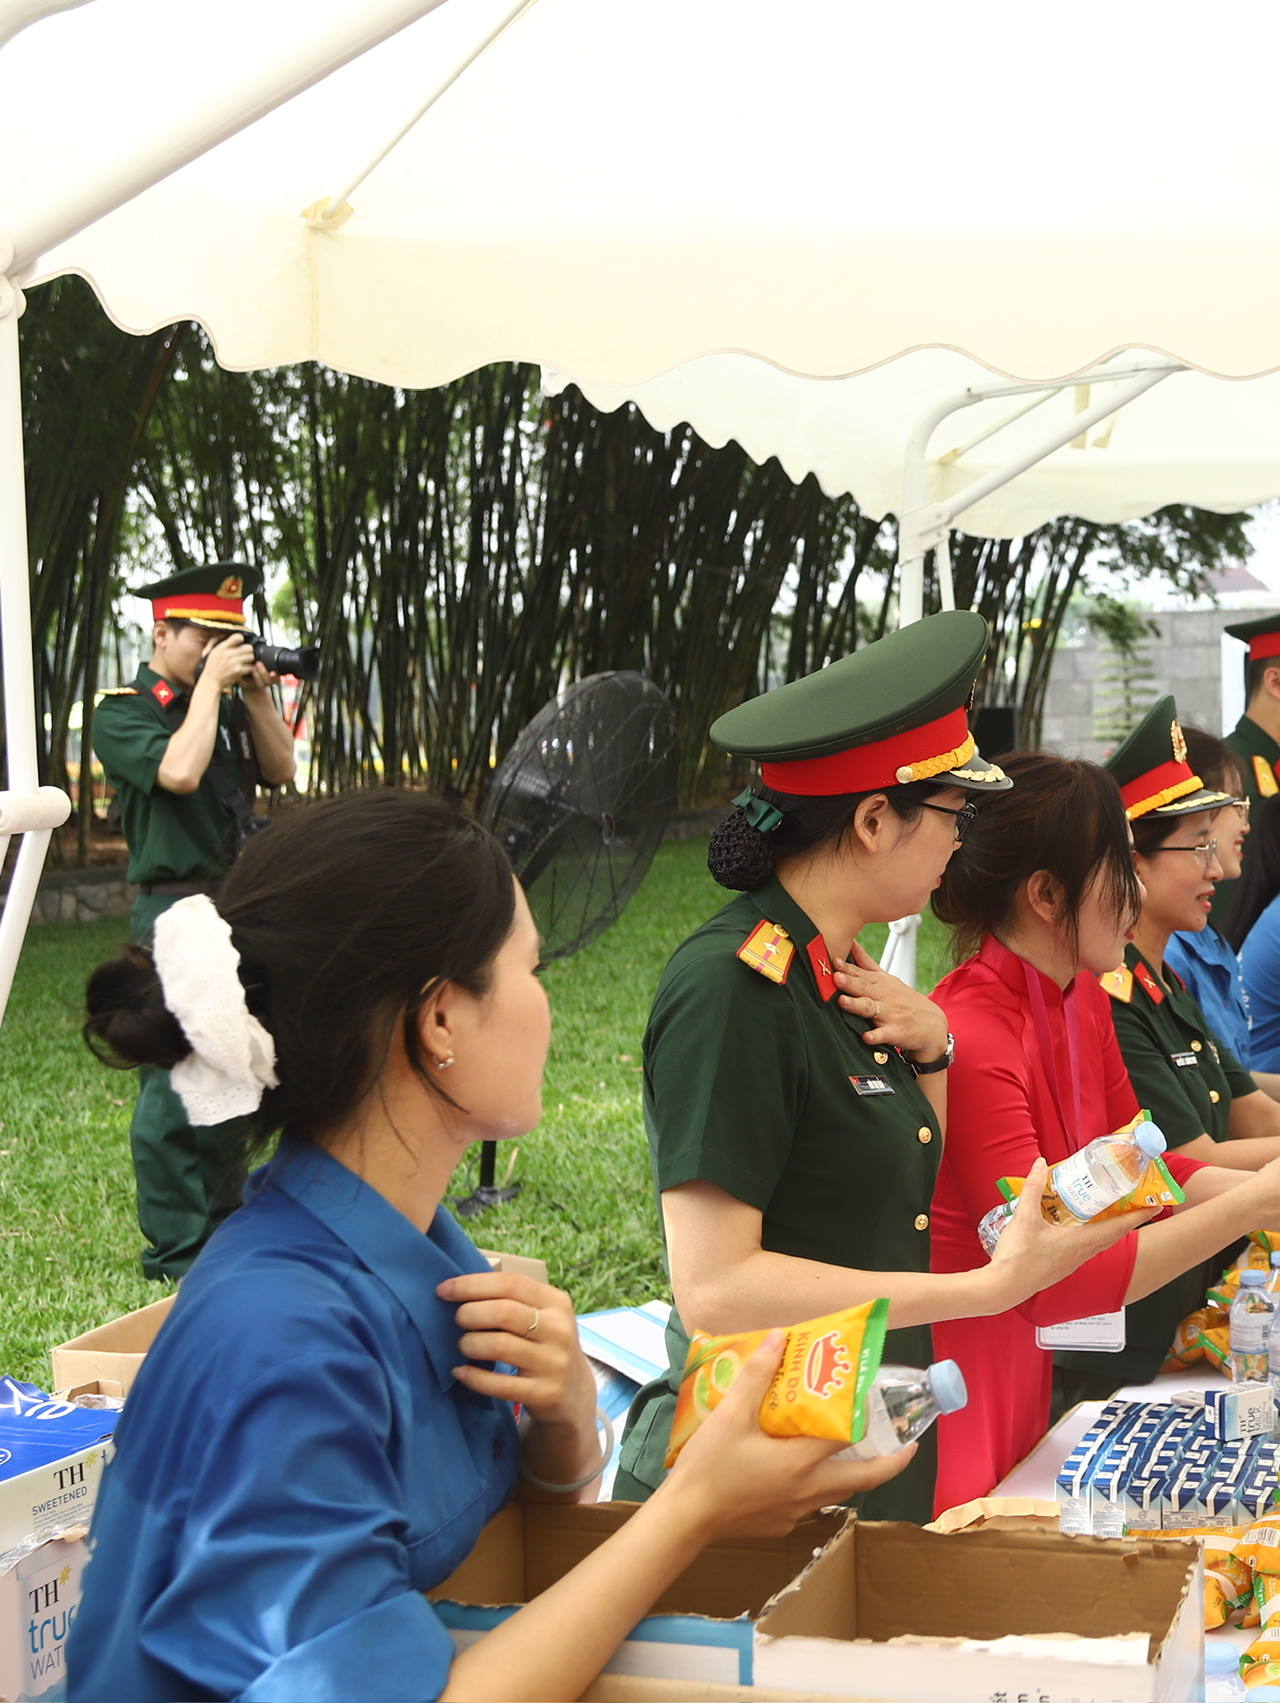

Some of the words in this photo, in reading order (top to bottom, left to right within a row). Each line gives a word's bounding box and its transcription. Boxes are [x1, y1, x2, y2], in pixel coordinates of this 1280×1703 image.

[1066, 1184, 1085, 1207] WATER
[1071, 1178, 1092, 1202] true
[788, 1331, 810, 1374] KINH
[1247, 1407, 1256, 1432] true
[53, 1462, 85, 1491] TH
[32, 1486, 88, 1516] SWEETENED
[29, 1577, 60, 1615] TH
[30, 1642, 67, 1680] WAT
